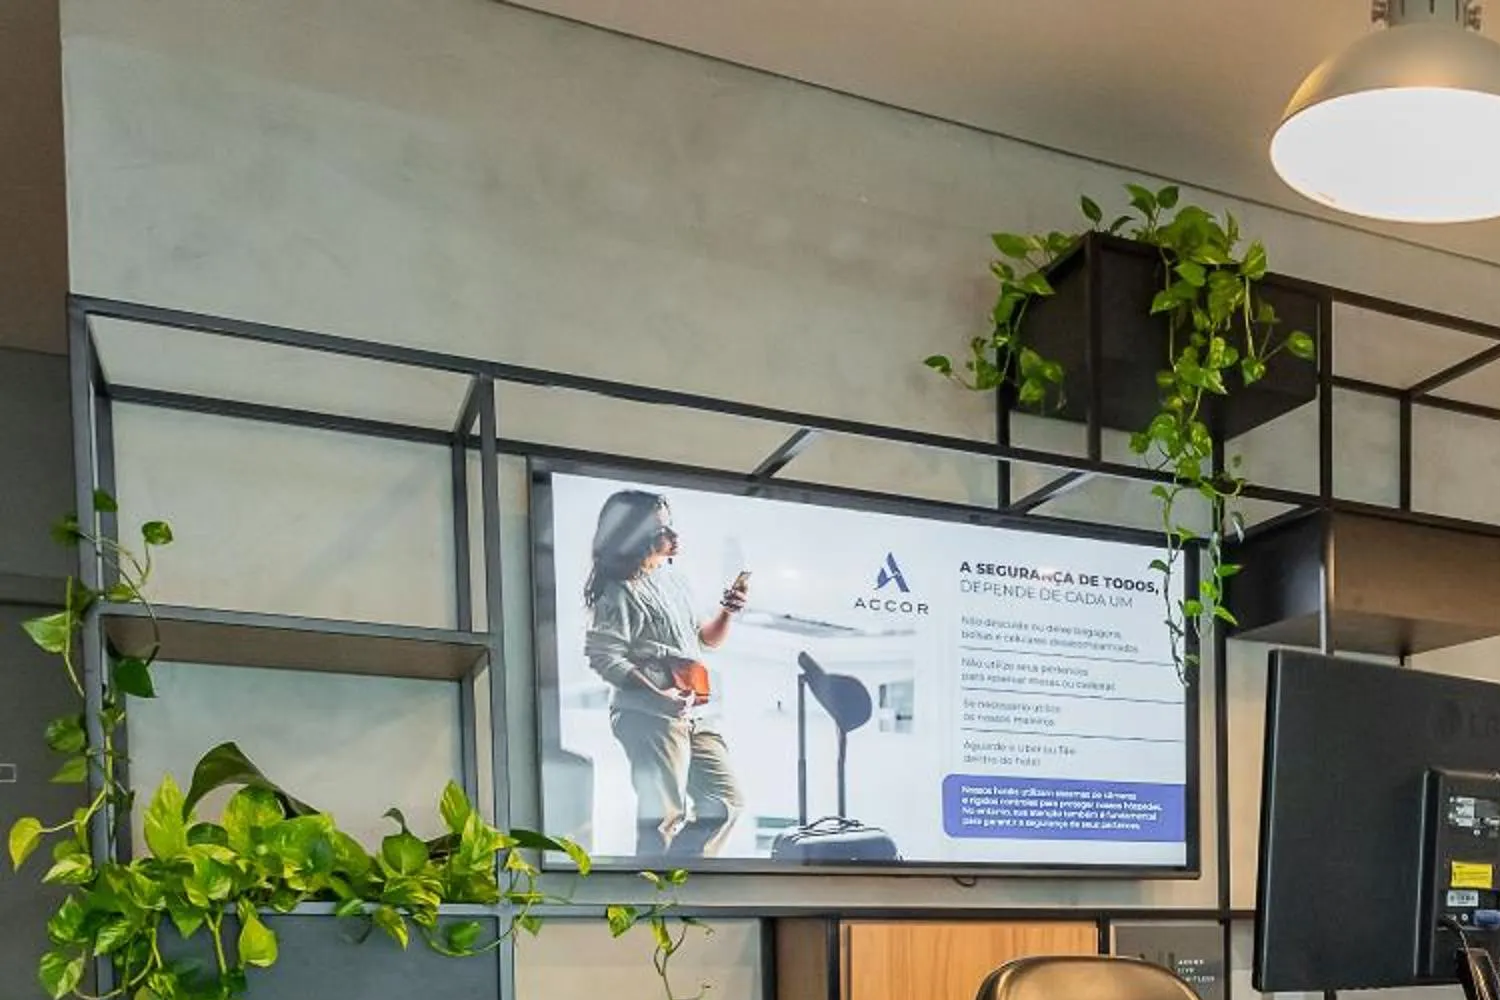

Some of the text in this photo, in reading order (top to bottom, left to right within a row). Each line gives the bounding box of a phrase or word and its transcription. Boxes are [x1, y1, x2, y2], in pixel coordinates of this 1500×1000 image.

[960, 561, 1159, 595] A SEGURANÇA DE TODOS,
[854, 597, 929, 615] ACCOR
[960, 579, 1134, 609] DEPENDE DE CADA UM
